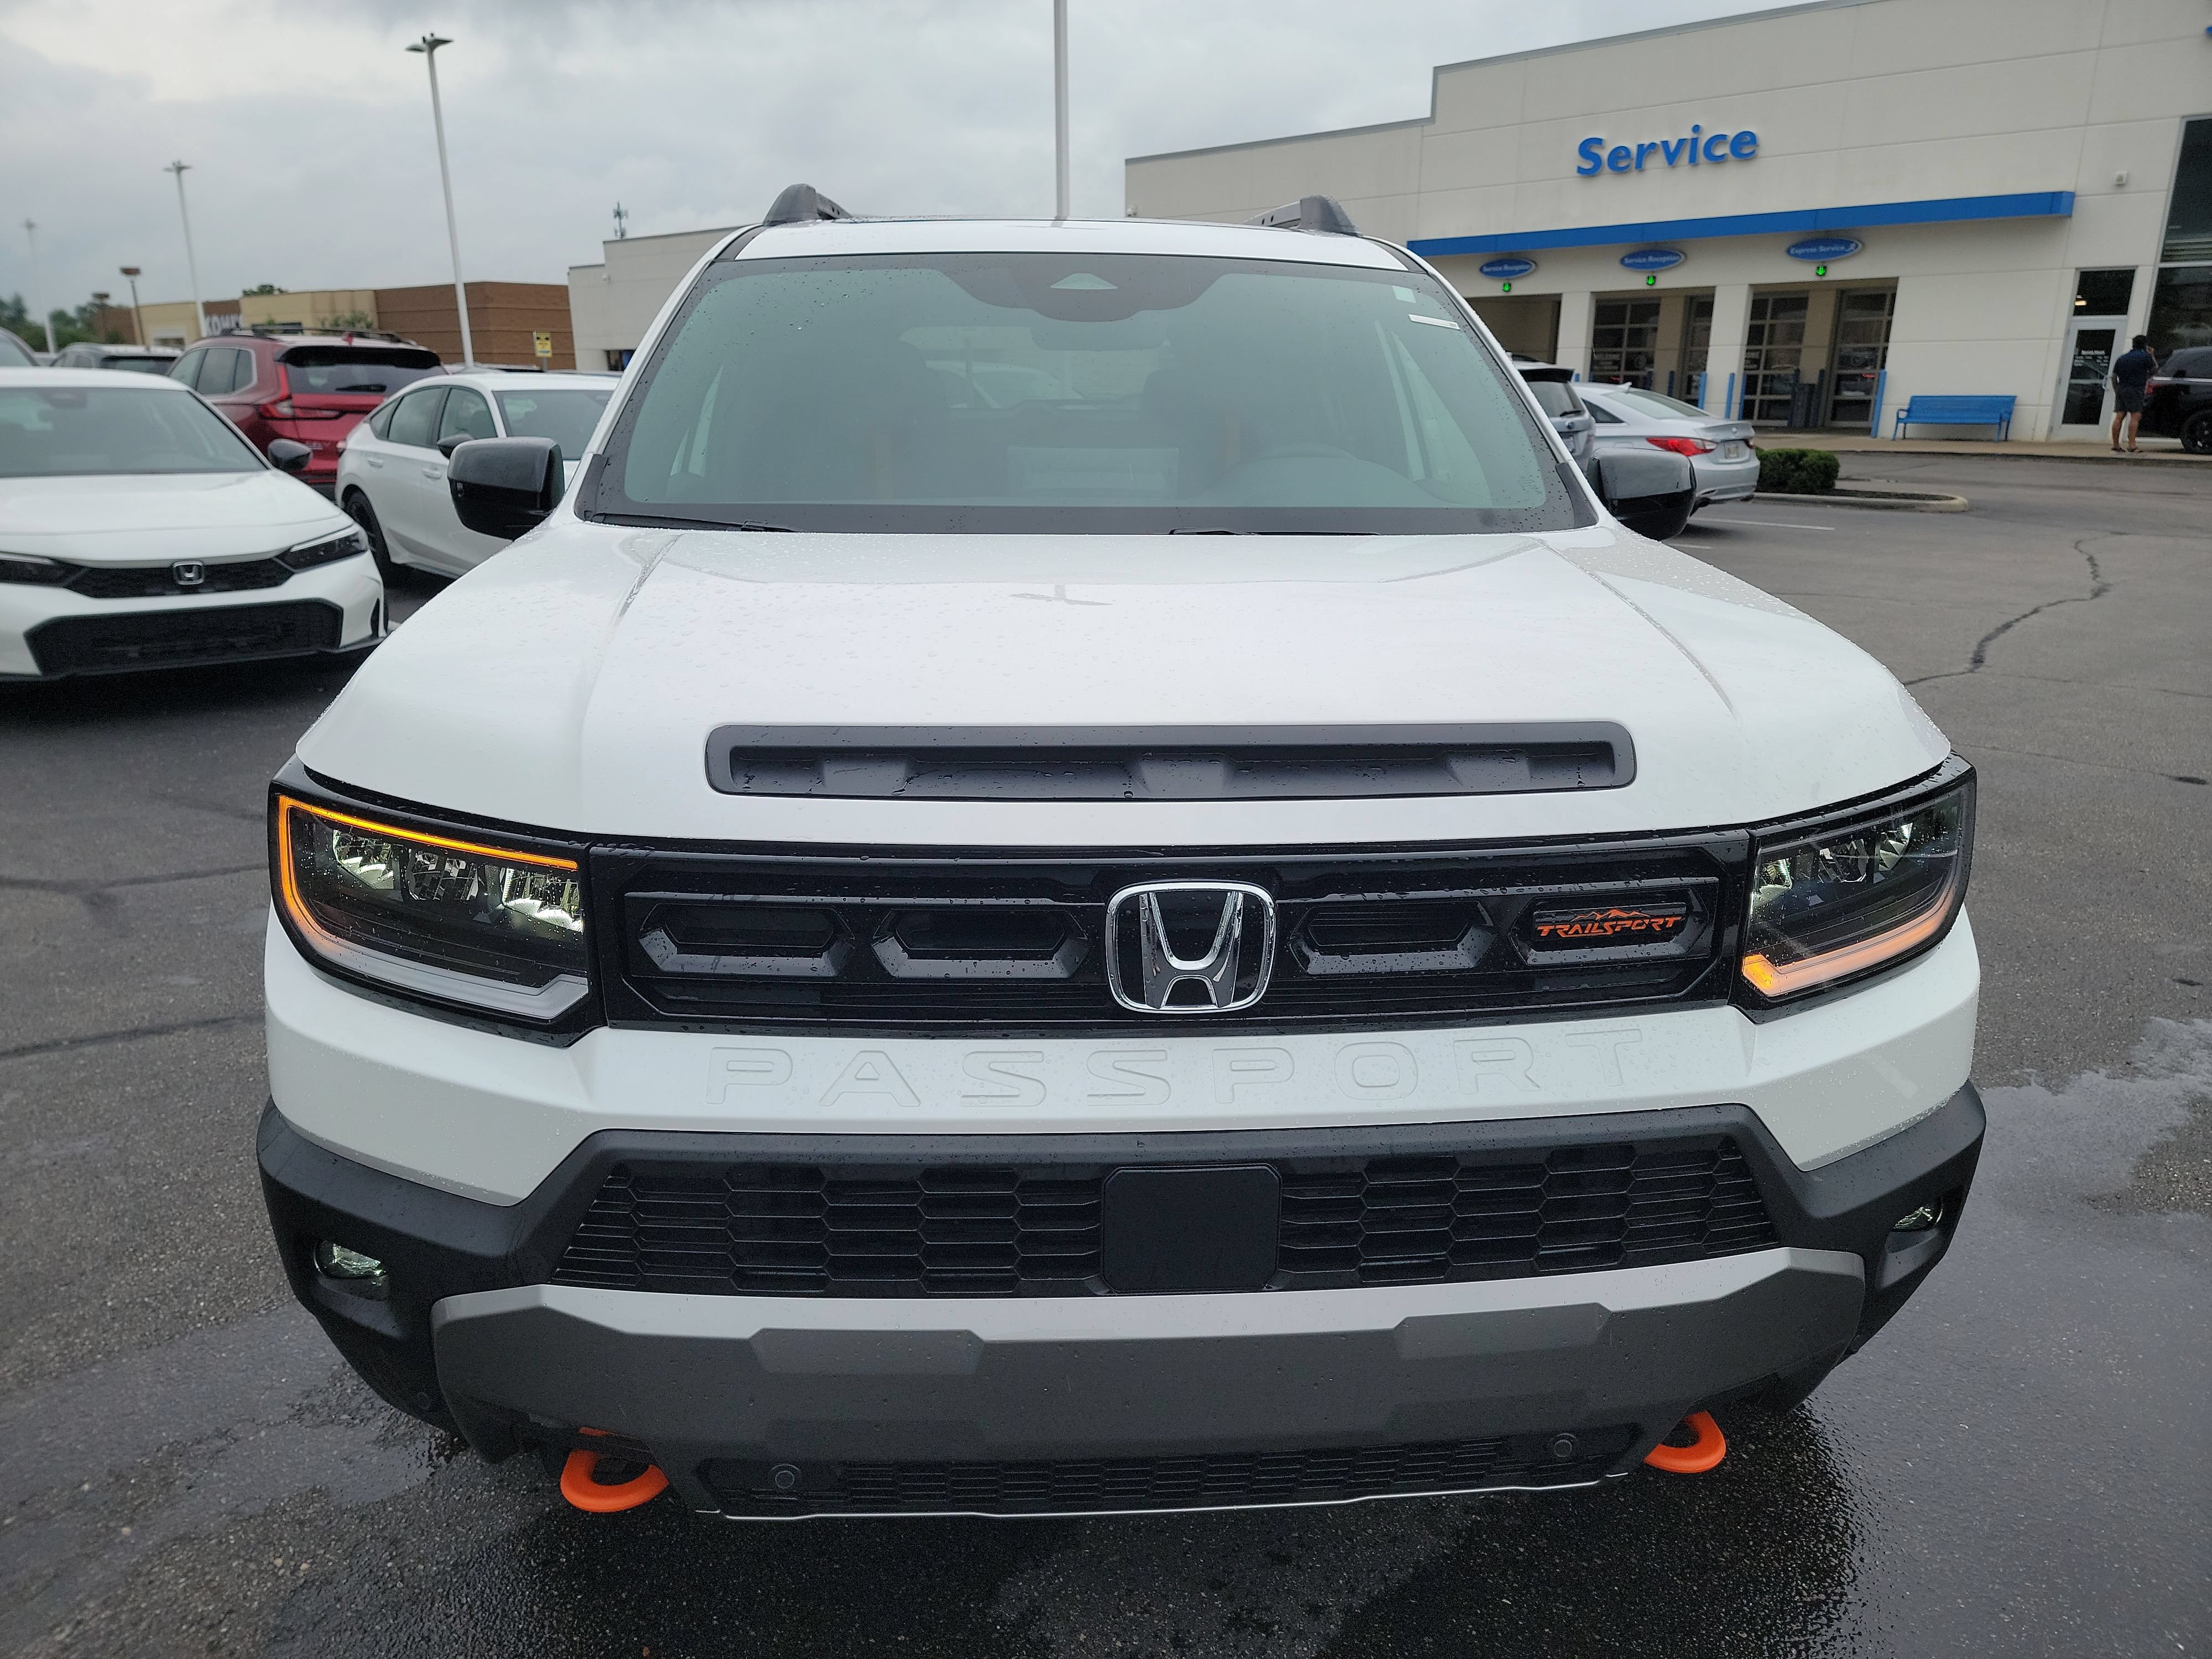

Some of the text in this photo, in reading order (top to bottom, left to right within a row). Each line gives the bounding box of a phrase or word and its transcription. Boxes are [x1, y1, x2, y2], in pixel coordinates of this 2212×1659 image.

[1577, 124, 1757, 176] Service
[1537, 916, 1682, 937] TRAILSPORT
[705, 1028, 1643, 1107] PASSPORT
